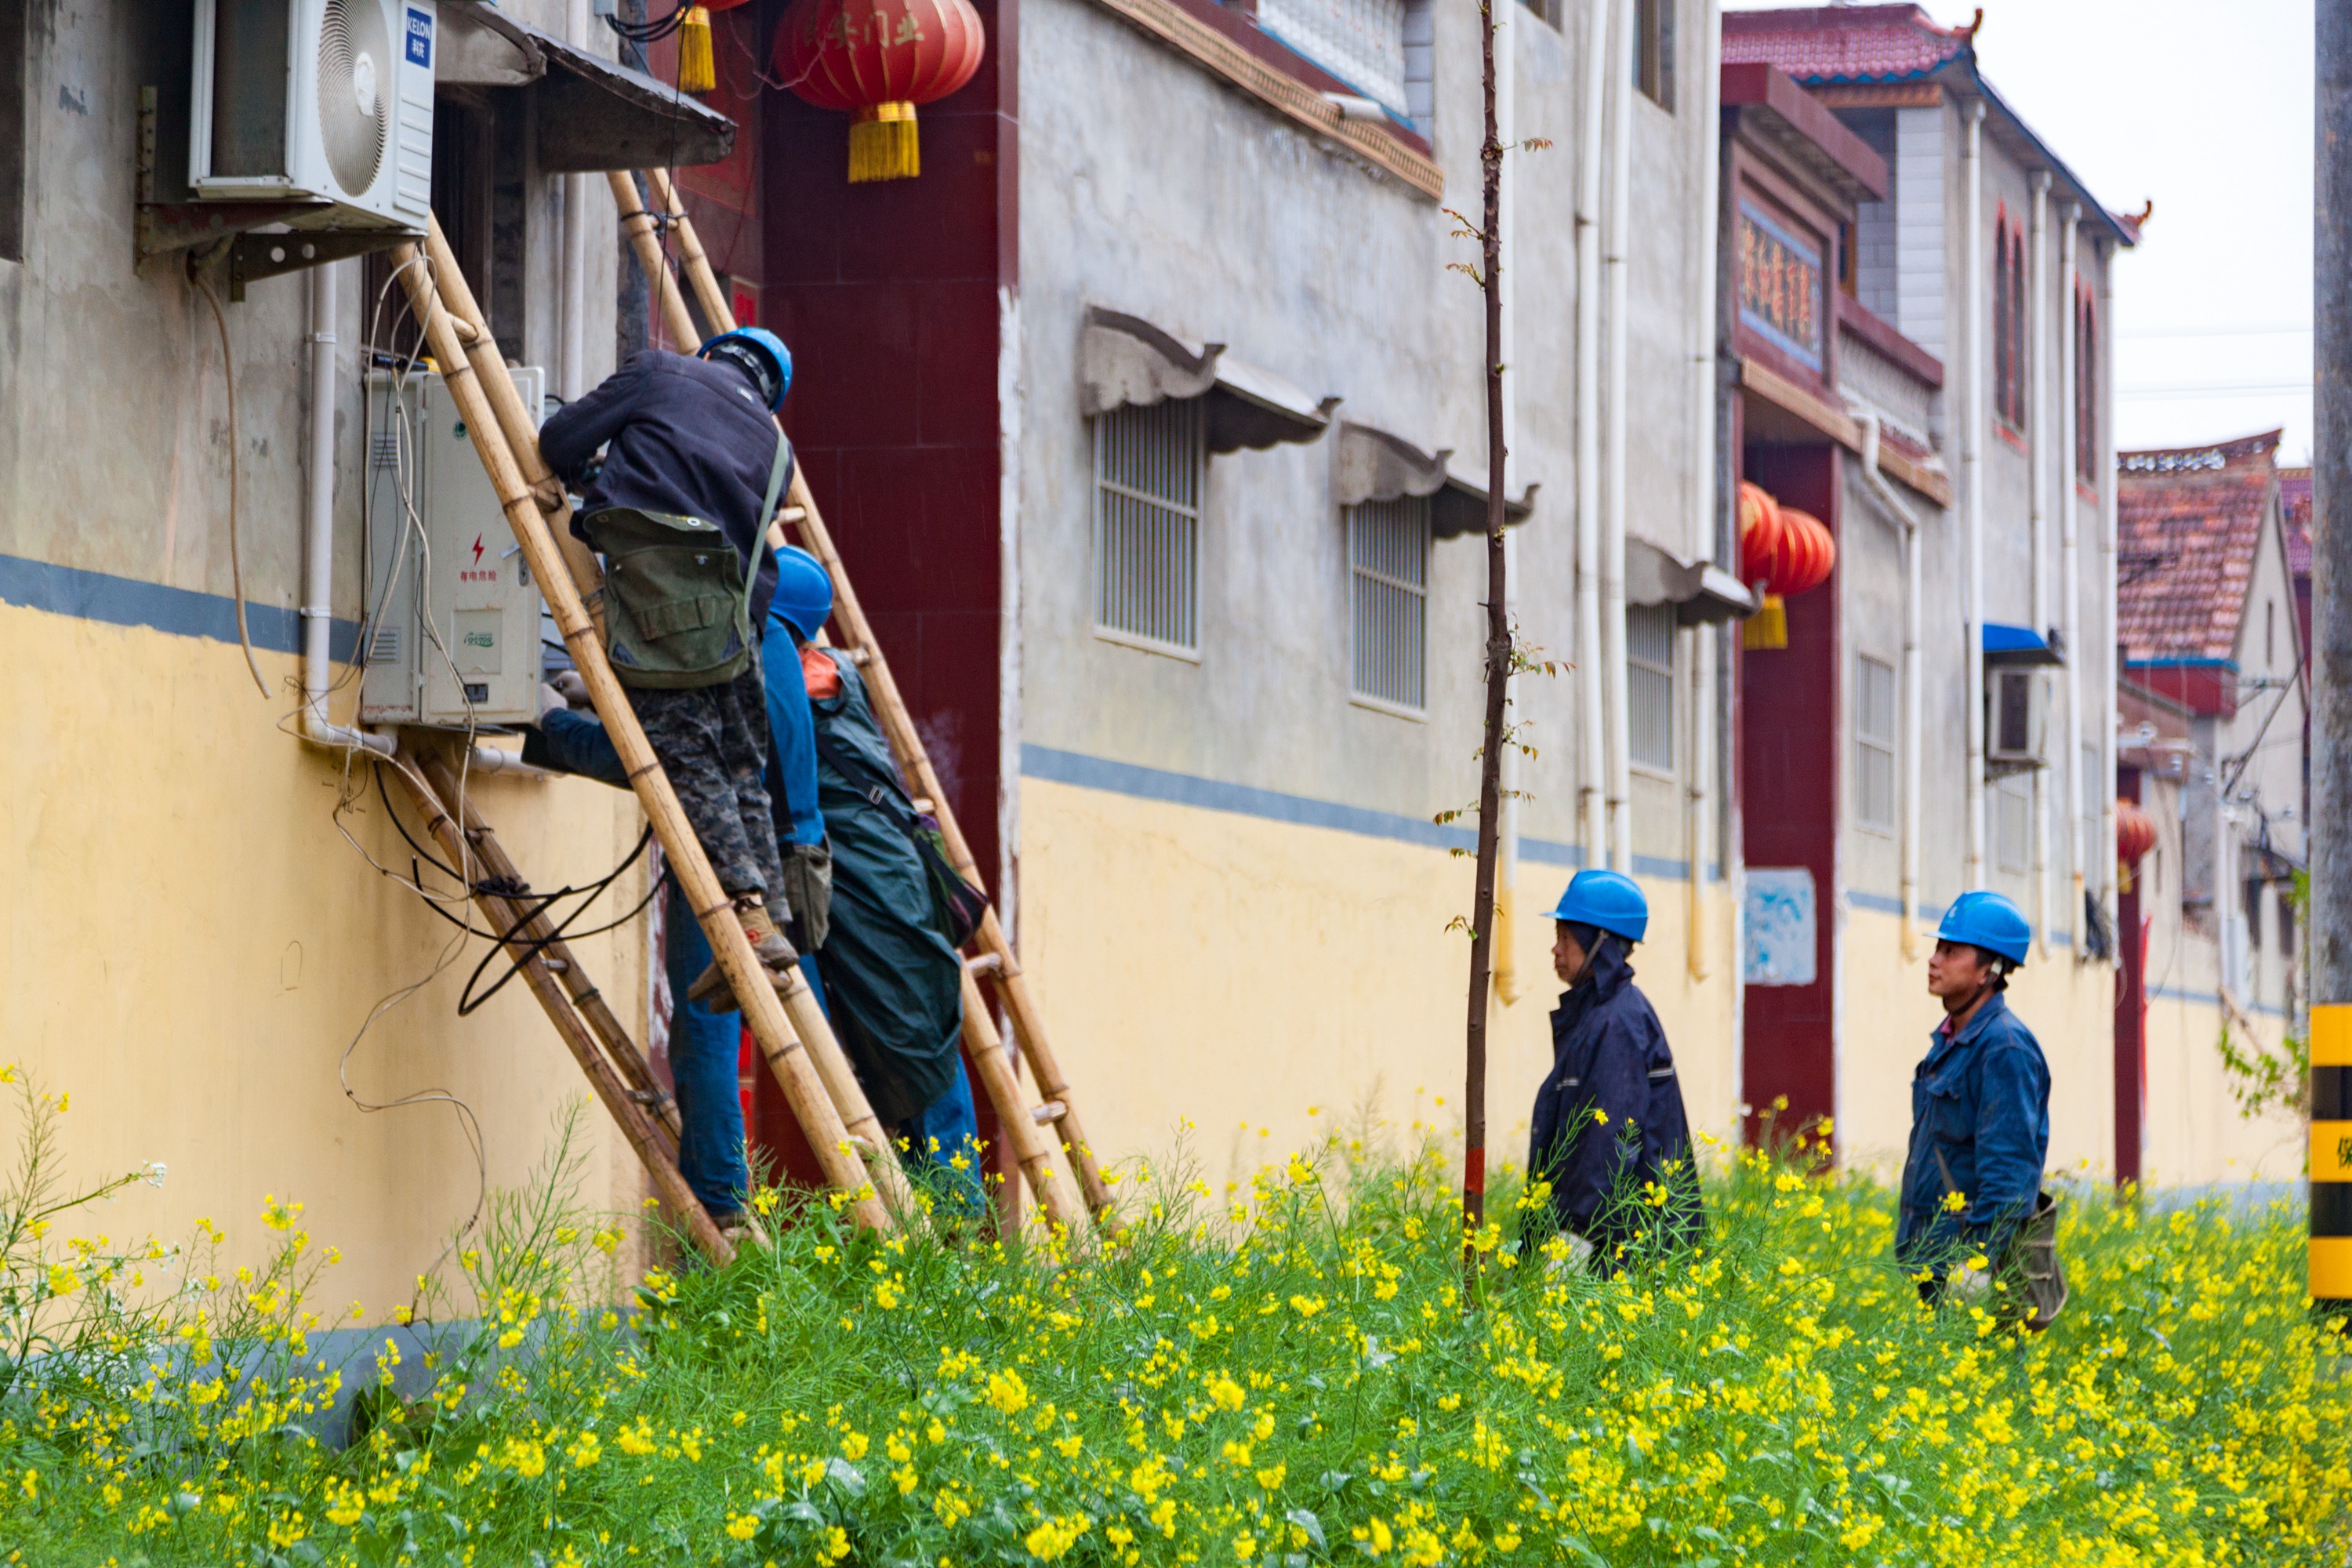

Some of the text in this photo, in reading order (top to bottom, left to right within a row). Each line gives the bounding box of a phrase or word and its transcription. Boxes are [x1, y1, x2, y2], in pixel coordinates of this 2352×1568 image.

[407, 16, 431, 41] KELON
[460, 570, 496, 583] 有电危险
